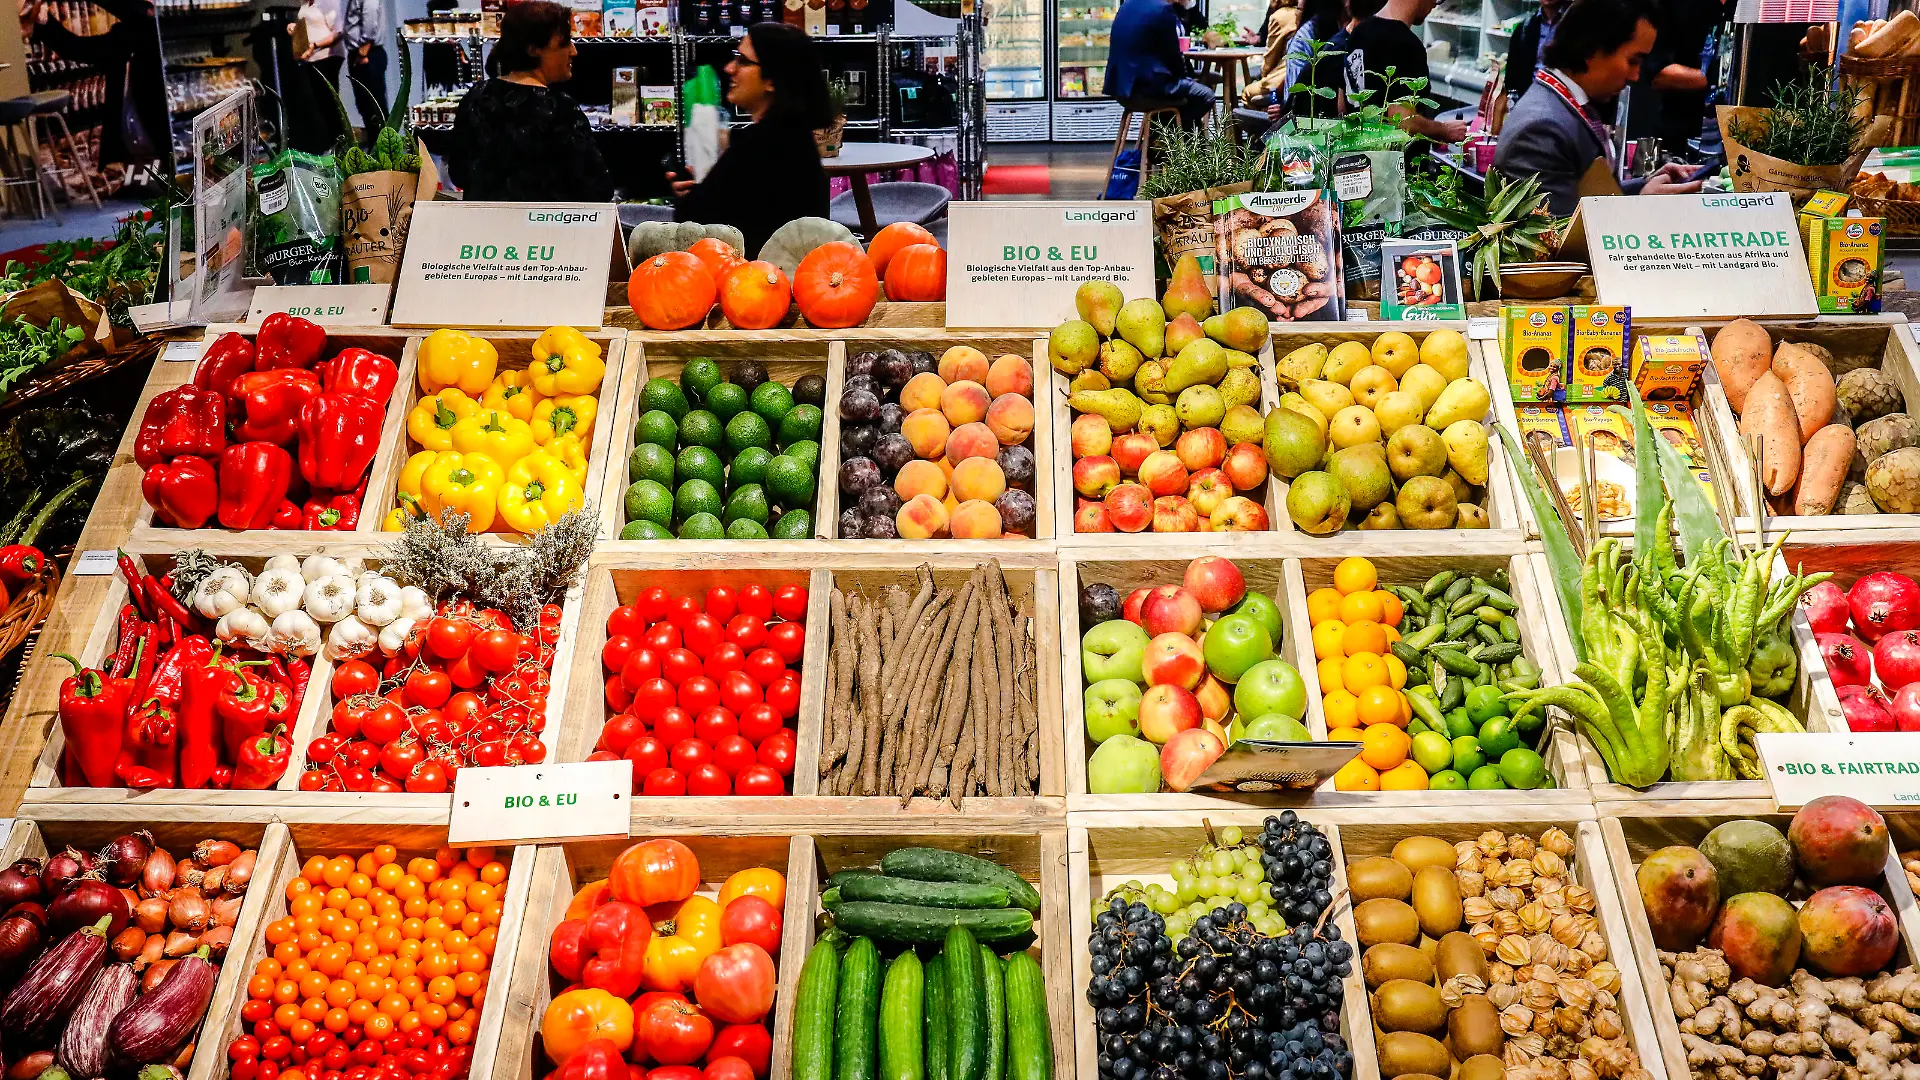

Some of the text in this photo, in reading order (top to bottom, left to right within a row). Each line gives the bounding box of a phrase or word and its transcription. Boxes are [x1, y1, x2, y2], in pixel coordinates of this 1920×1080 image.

[1250, 193, 1307, 206] Almaverde
[1702, 195, 1774, 209] Landgard
[528, 211, 599, 224] Landgard
[1065, 210, 1137, 223] Landgard
[1175, 232, 1214, 248] KRÄUT
[1247, 234, 1316, 248] BIODYNAMISCH
[1602, 231, 1790, 250] BIO & FAIRTRADE
[346, 241, 388, 256] RÄUTER
[459, 244, 556, 261] BIO & EU
[1003, 245, 1098, 261] BIO & EU
[1244, 245, 1320, 258] UND BIOLOGISCH
[1260, 256, 1285, 265] BESSER
[1608, 254, 1624, 262] Fair
[1626, 252, 1676, 263] gehandelte
[1677, 251, 1725, 260] Bio-Exoten
[1744, 250, 1770, 259] Afrika
[1772, 250, 1789, 258] und
[421, 263, 588, 273] Biologische Vielfalt aus den Top-Anbau-
[966, 264, 1016, 273] Biologische
[1018, 264, 1050, 272] Vielfalt
[1068, 264, 1084, 272] den
[1086, 264, 1135, 273] Top-Anbau-
[1623, 263, 1638, 271] der
[1640, 263, 1671, 272] ganzen
[1673, 262, 1694, 270] Welt
[1718, 261, 1760, 270] Landgard
[1762, 260, 1779, 269] Bio.
[424, 272, 462, 281] gebieten
[464, 273, 498, 282] Europas
[523, 274, 563, 282] Landgard
[565, 274, 581, 282] Bio.
[971, 274, 1009, 283] gebieten
[1011, 274, 1046, 283] Europas
[1054, 274, 1068, 282] mit
[1070, 274, 1111, 282] Landgard
[1113, 274, 1130, 282] Bio.
[288, 306, 345, 316] BIO & EU
[1522, 329, 1553, 337] Bio-Ananas
[1576, 329, 1622, 337] Bio-Baby-Bananen
[1785, 762, 1920, 775] BIO & FAIRTRAD
[504, 793, 577, 809] BIO & EU
[1894, 793, 1920, 801] Land
